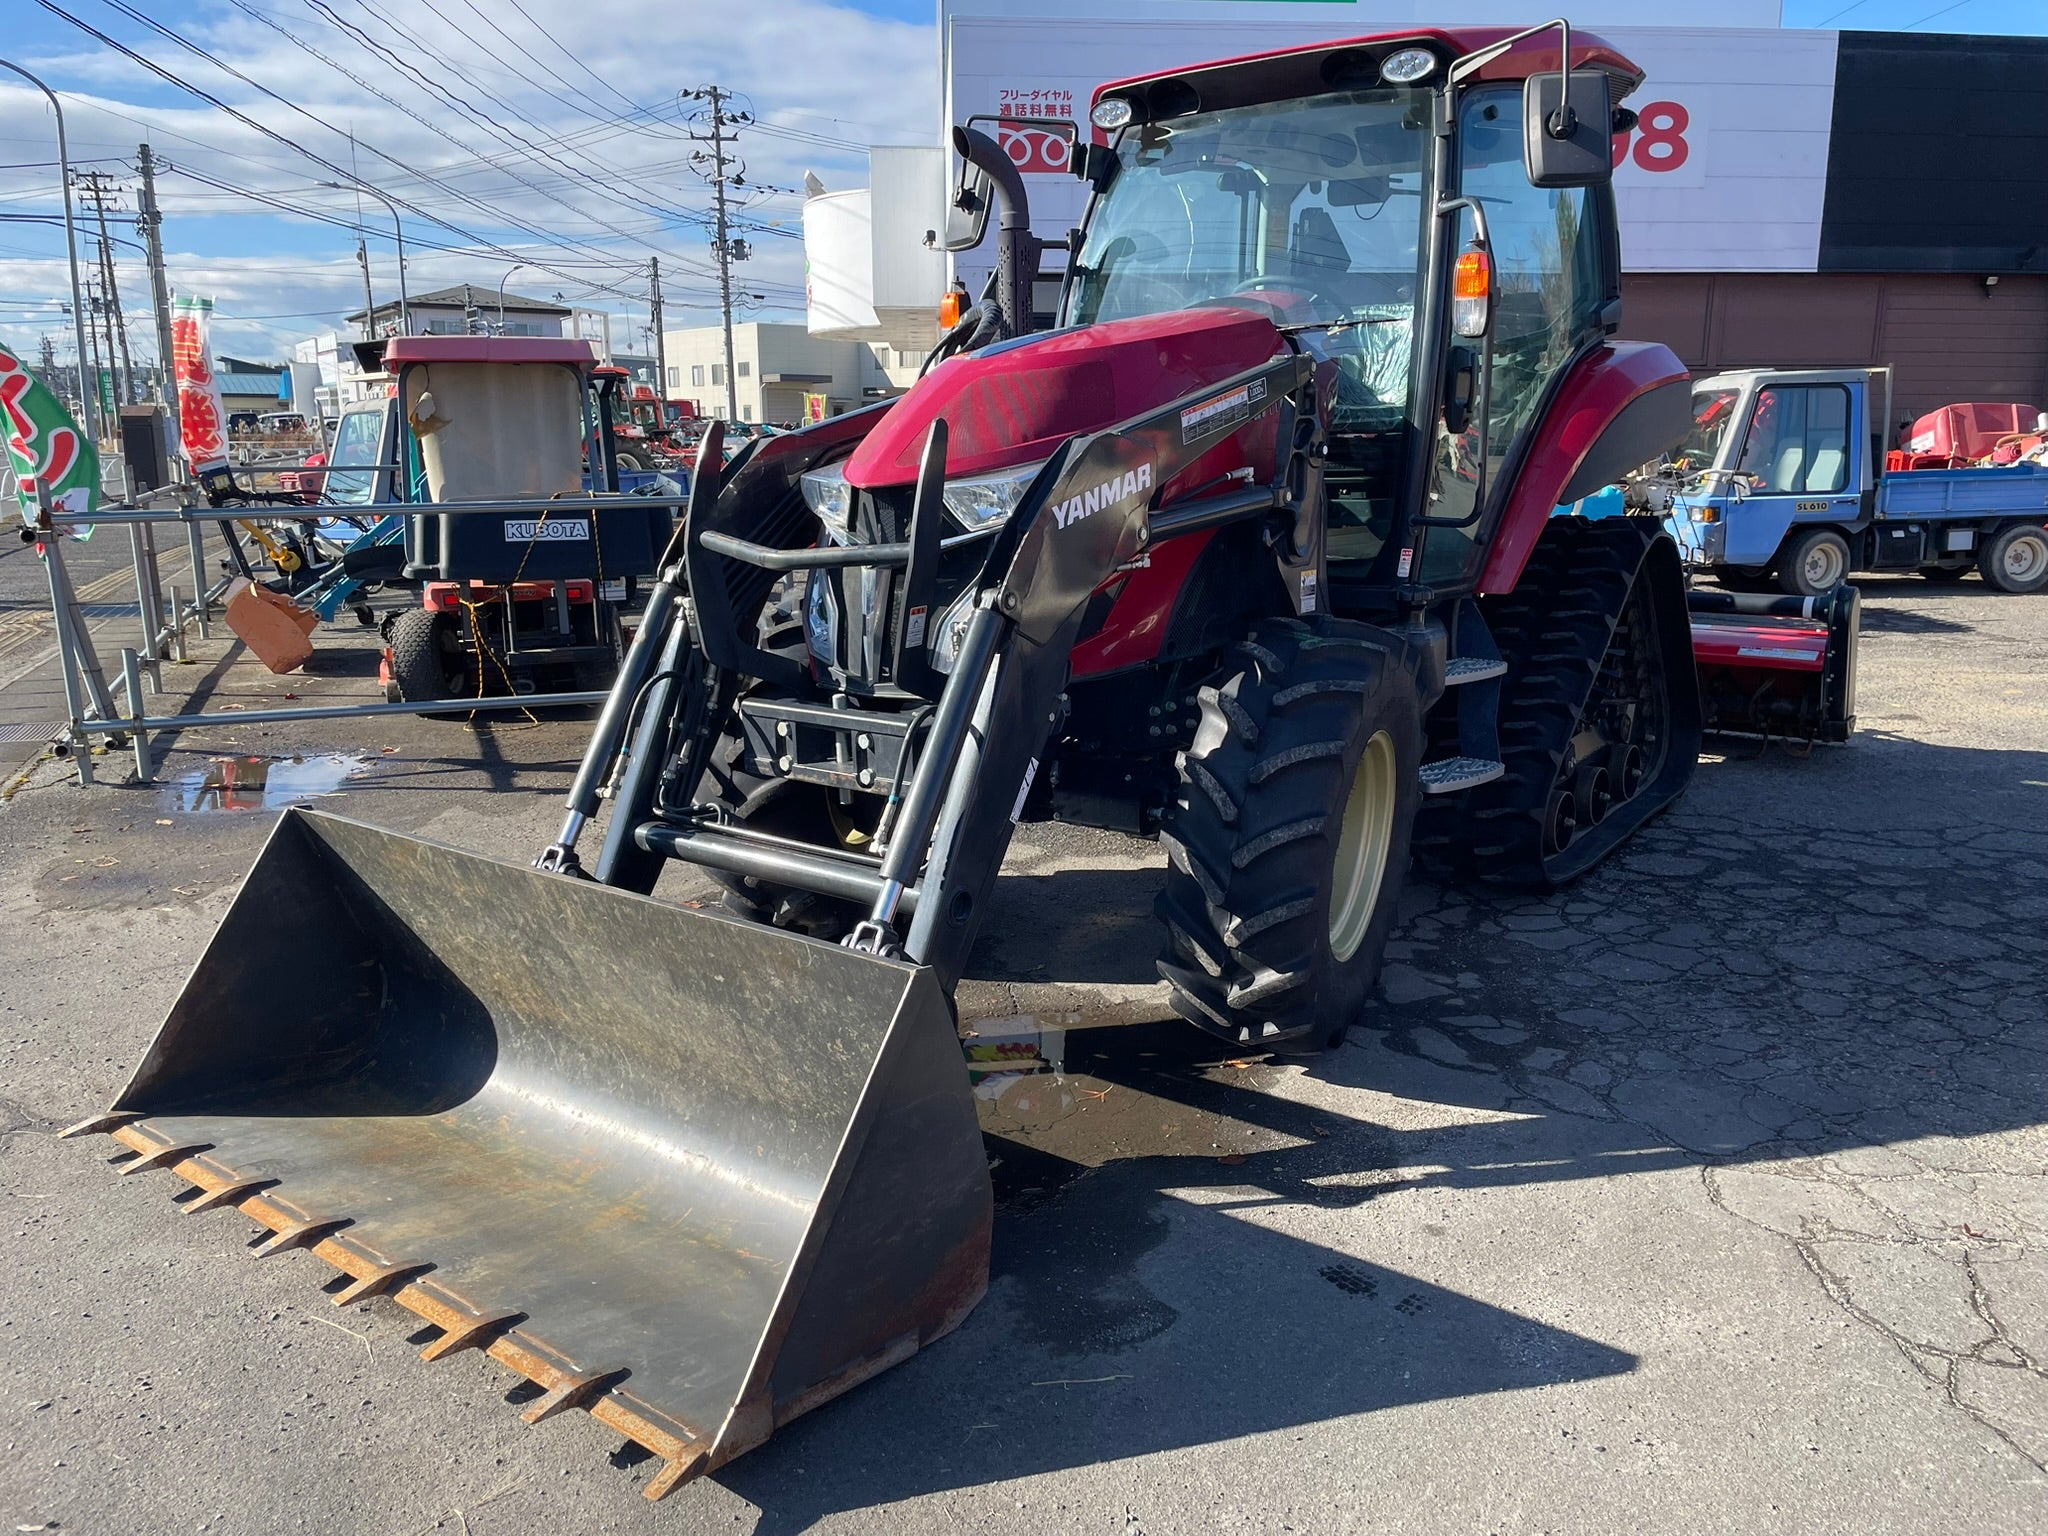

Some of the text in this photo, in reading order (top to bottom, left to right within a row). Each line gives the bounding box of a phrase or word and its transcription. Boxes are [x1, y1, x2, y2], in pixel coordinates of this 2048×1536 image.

[1000, 89, 1073, 101] フリーダイヤル
[1000, 103, 1072, 117] 通話料無料
[1051, 462, 1152, 530] YANMAR
[1797, 502, 1828, 511] SL 610
[505, 521, 588, 538] KUBOTA
